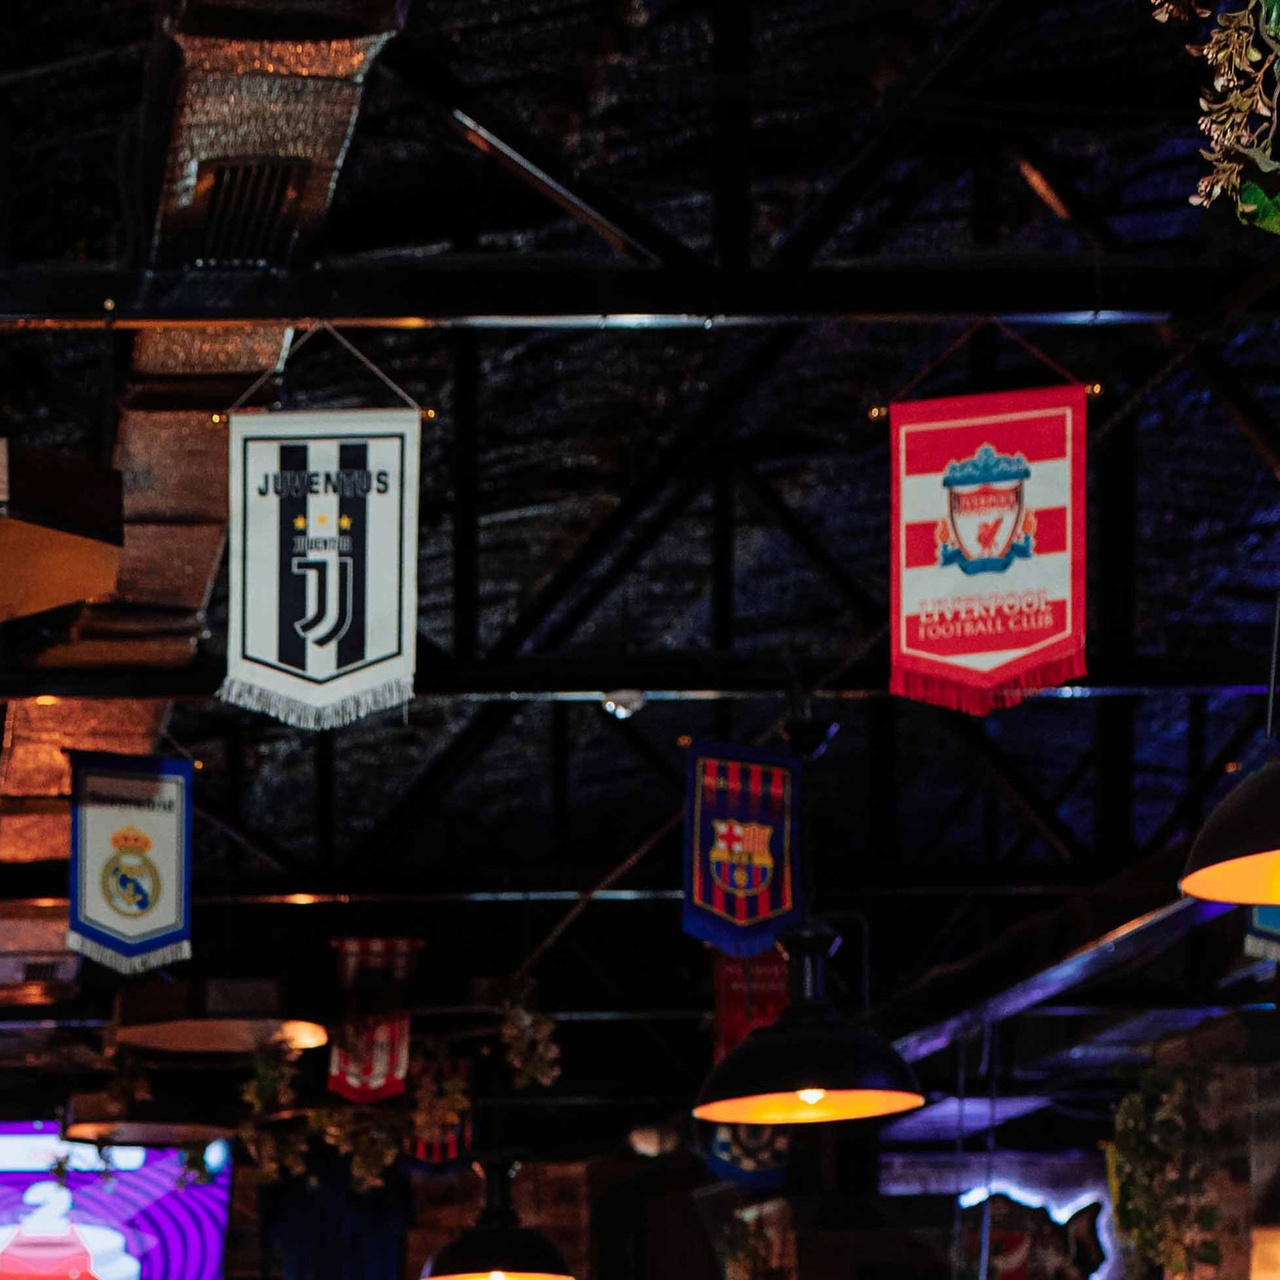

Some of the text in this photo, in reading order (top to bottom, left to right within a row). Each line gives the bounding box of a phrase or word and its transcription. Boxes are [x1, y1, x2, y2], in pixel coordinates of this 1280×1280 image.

[257, 469, 390, 498] JUVENTUS
[918, 588, 1053, 623] LIVERPOOL
[918, 611, 1054, 641] FOOTBALL CLUB
[23, 1182, 73, 1237] 2
